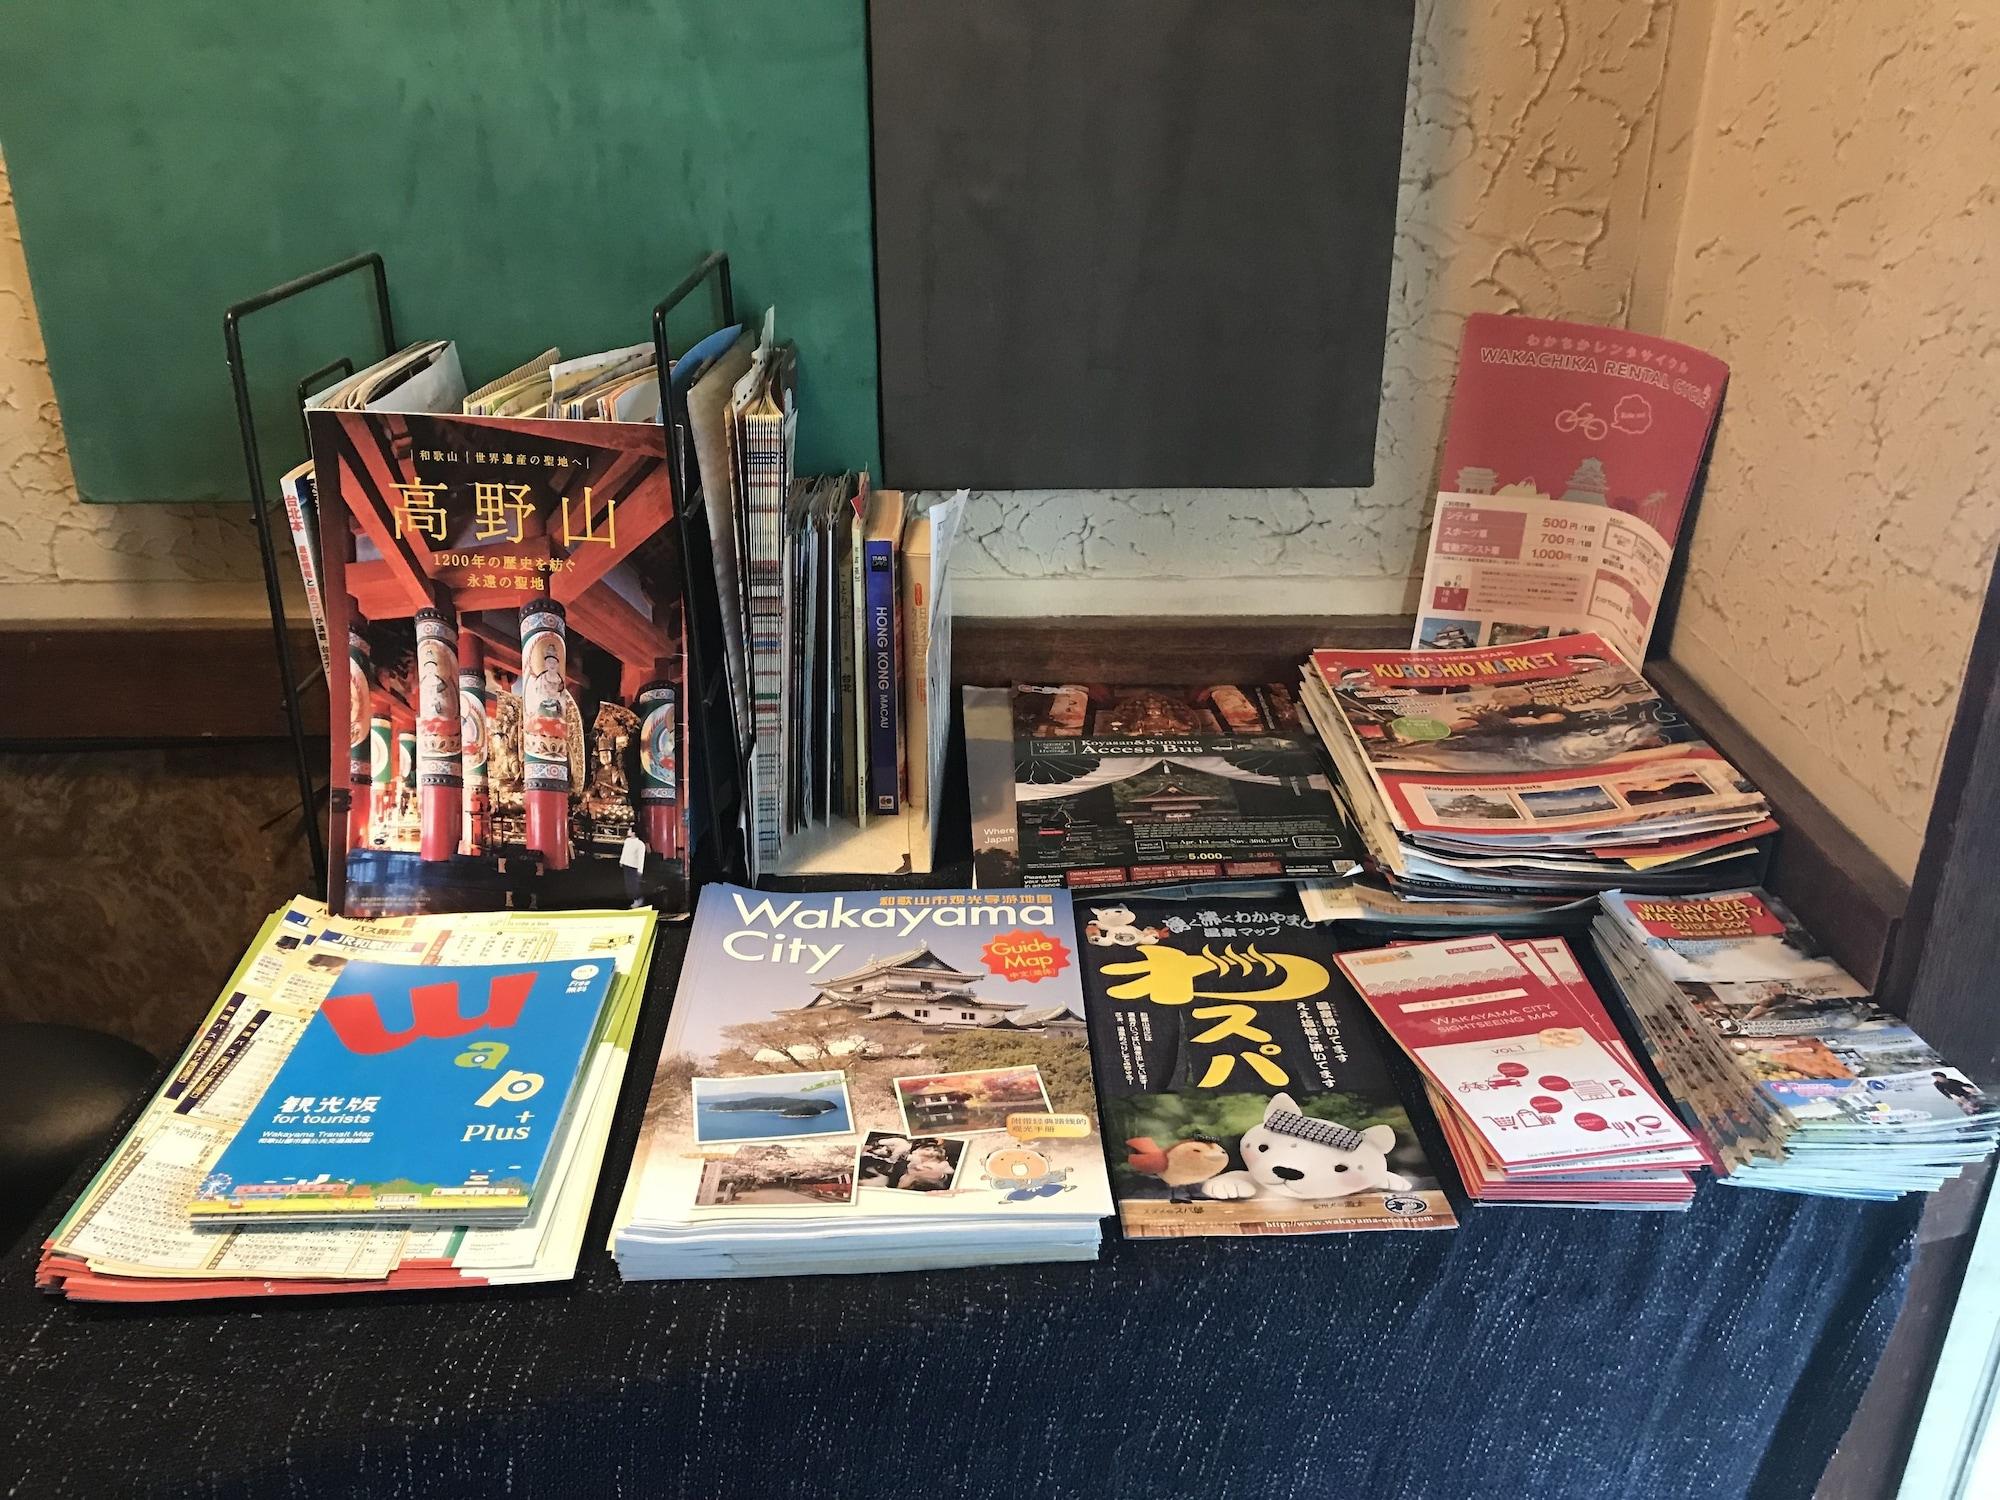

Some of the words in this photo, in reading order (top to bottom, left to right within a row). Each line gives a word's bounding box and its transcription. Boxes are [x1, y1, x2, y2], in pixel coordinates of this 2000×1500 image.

[1481, 347, 1598, 374] WAKACHIKA
[1604, 363, 1671, 391] RENTAL
[419, 449, 458, 463] 和歌山
[475, 451, 582, 468] 世界遺産の聖地へ
[388, 476, 616, 550] 高野山
[433, 553, 576, 574] 1200年の歴史を紡ぐ
[467, 574, 545, 591] 永遠の聖地
[876, 606, 889, 652] HONG
[877, 652, 890, 691] KONG
[1372, 660, 1477, 681] KUROSHIO
[1482, 652, 1558, 676] MARKET
[879, 694, 889, 729] MACAU
[1081, 745, 1155, 754] Access
[1162, 743, 1204, 754] Bus
[983, 827, 1015, 836] Where
[984, 835, 1014, 845] Japan
[879, 895, 1053, 907] 和歌山市观光导游地图
[1638, 899, 1748, 914] WAKAYAMA
[732, 892, 1056, 938] Wakayama
[1636, 910, 1717, 923] MARINA
[1719, 905, 1764, 921] CITY
[1203, 925, 1282, 938] 温泉マップ
[1670, 921, 1712, 931] GUIDE
[1714, 919, 1752, 931] BOOK
[722, 929, 846, 975] City
[991, 939, 1054, 957] Guide
[1004, 953, 1054, 971] Map
[1430, 1007, 1520, 1028] WAKAYAMA
[1522, 1001, 1552, 1016] CITY
[1436, 1015, 1526, 1034] SIGHTSEEING
[1527, 1008, 1559, 1026] MAP
[277, 1095, 381, 1114] 観光版
[271, 1113, 299, 1124] for
[302, 1113, 371, 1124] tourists
[262, 1131, 315, 1139] Wakayama
[352, 1131, 374, 1140] Map
[460, 1123, 531, 1142] Plus
[1265, 1212, 1435, 1229] http://www.wakayama-onsen.com
